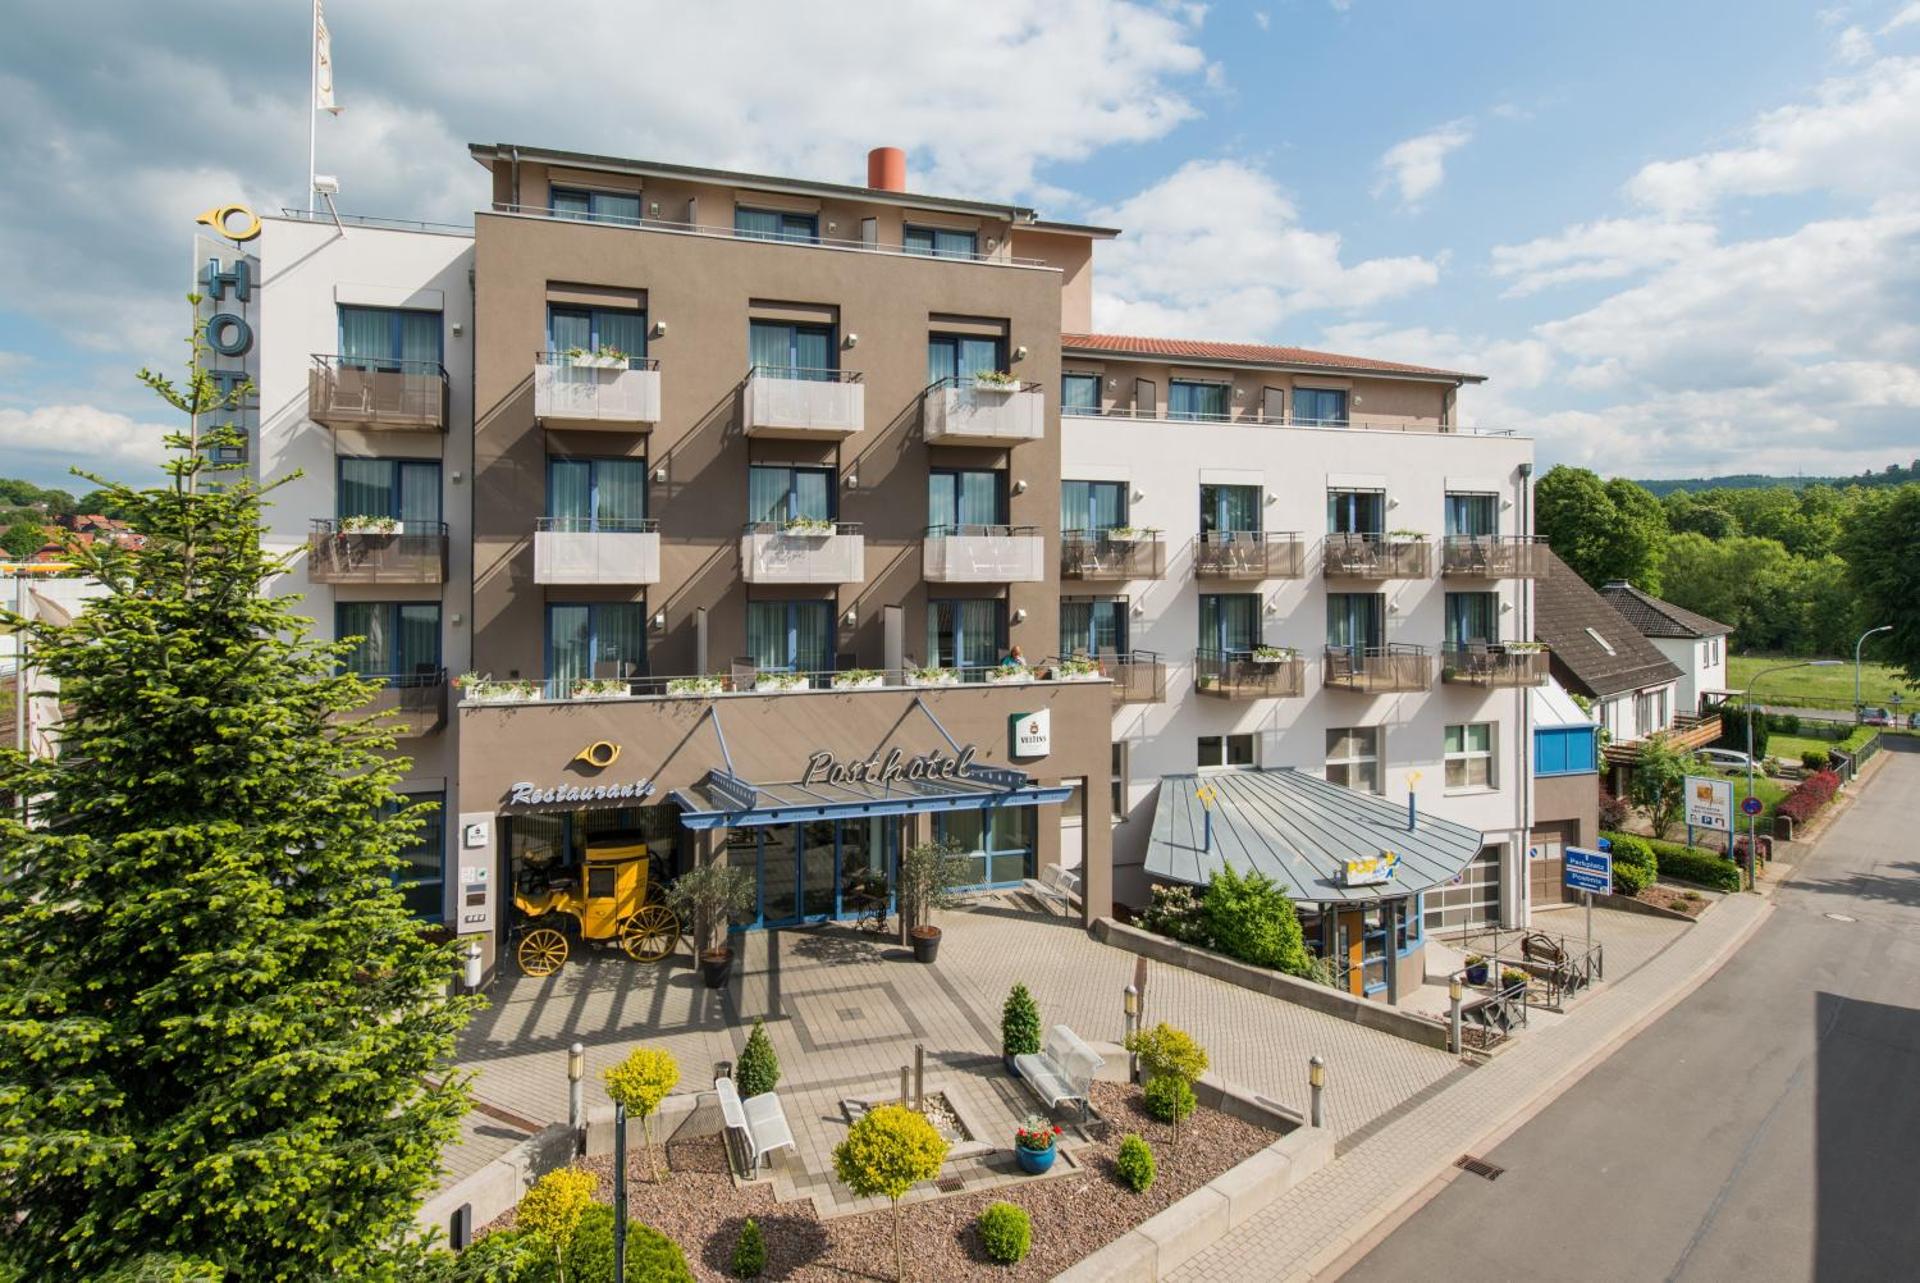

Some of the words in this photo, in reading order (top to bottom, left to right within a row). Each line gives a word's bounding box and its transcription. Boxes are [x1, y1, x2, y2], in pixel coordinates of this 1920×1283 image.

[206, 258, 251, 494] HOTE
[803, 744, 976, 787] Posthotel
[510, 777, 657, 805] Restaurants
[1569, 858, 1605, 871] Parkplatz
